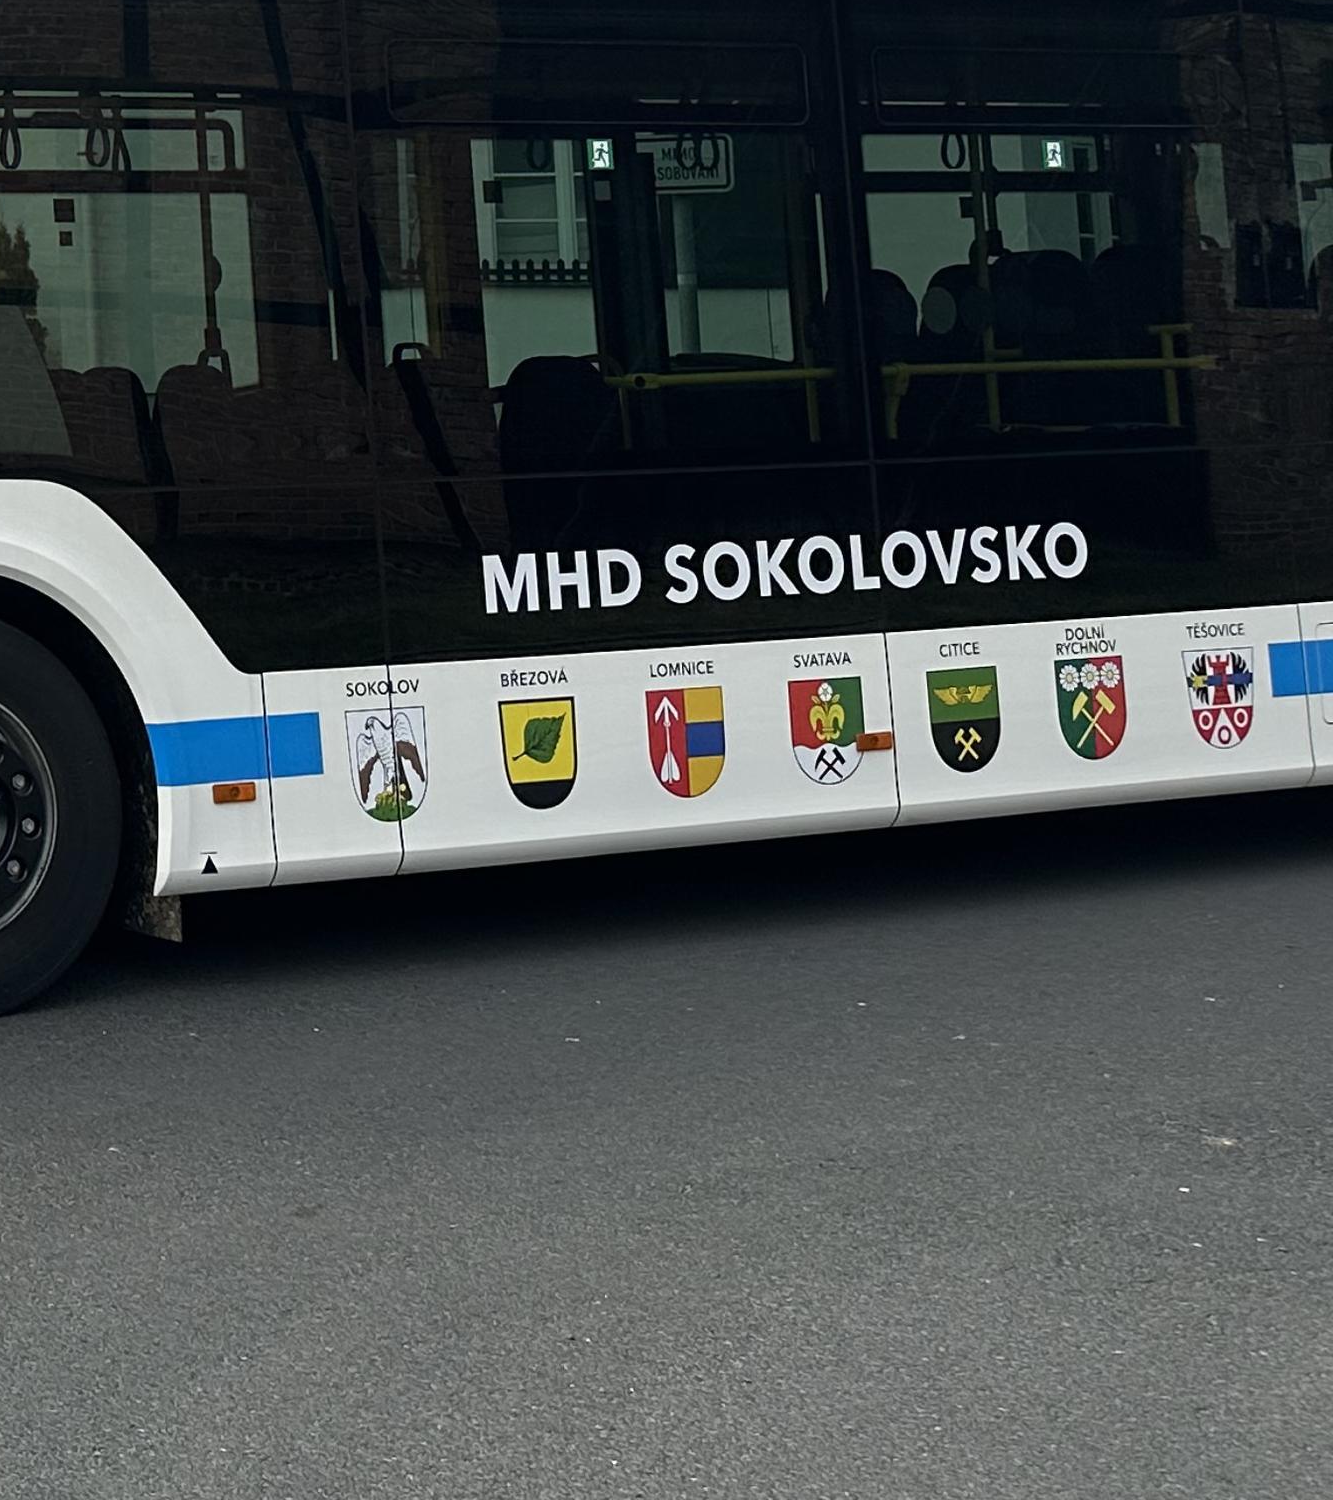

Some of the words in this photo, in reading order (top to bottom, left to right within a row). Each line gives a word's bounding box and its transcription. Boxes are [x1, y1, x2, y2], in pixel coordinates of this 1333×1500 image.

[482, 548, 642, 614] MHD
[664, 522, 1089, 604] SOKOLOVSKO
[1064, 623, 1105, 641] DOLNÍ
[1186, 622, 1245, 639] TĚŠOVICE
[939, 641, 981, 658] CITICE
[1055, 639, 1117, 656] RYCHNOV
[649, 660, 715, 678] LOMNICE
[793, 651, 852, 669] SVATAVA
[500, 666, 569, 688] BŘEZOVÁ
[345, 678, 420, 698] SOKOLOV
